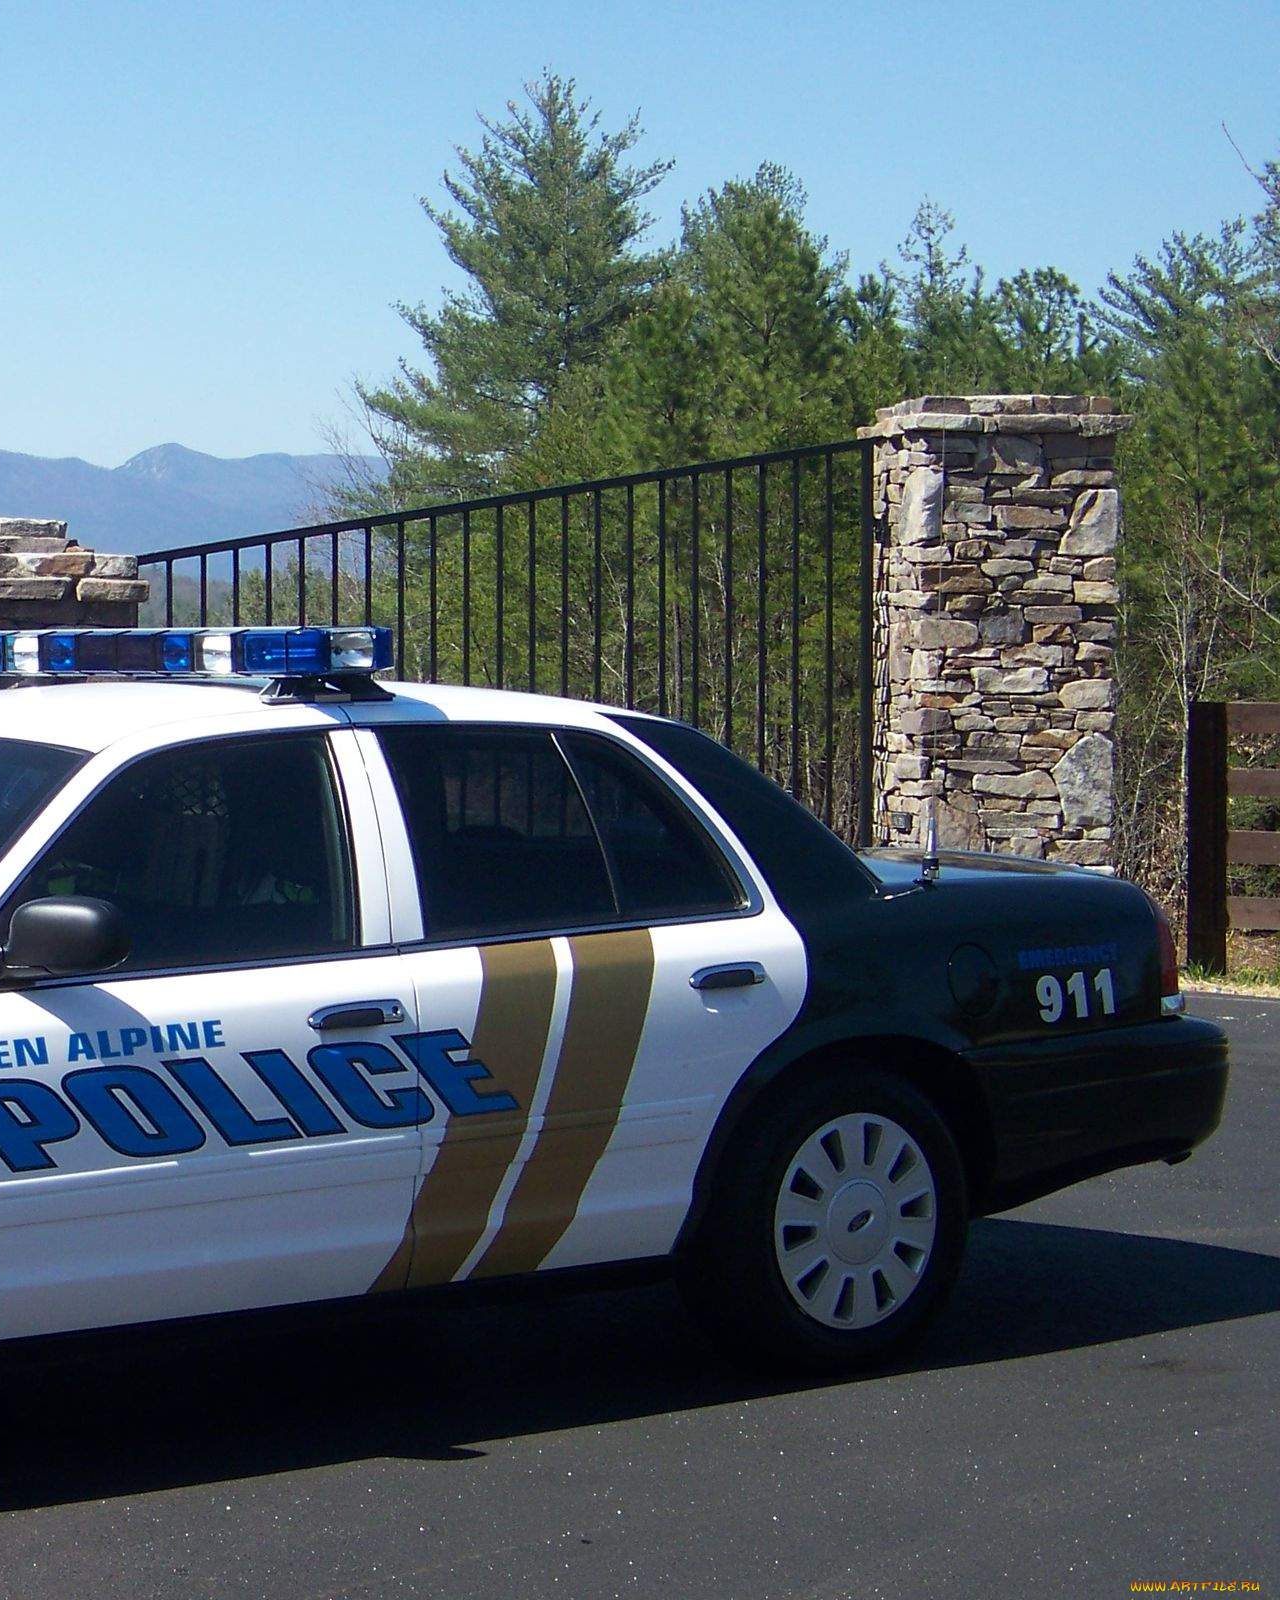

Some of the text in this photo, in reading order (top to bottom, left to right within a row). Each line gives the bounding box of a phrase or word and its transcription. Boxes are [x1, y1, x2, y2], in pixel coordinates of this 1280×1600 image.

[1018, 944, 1117, 970] EMERGENCY
[1036, 968, 1115, 1023] 911
[67, 1019, 226, 1062] ALPINE
